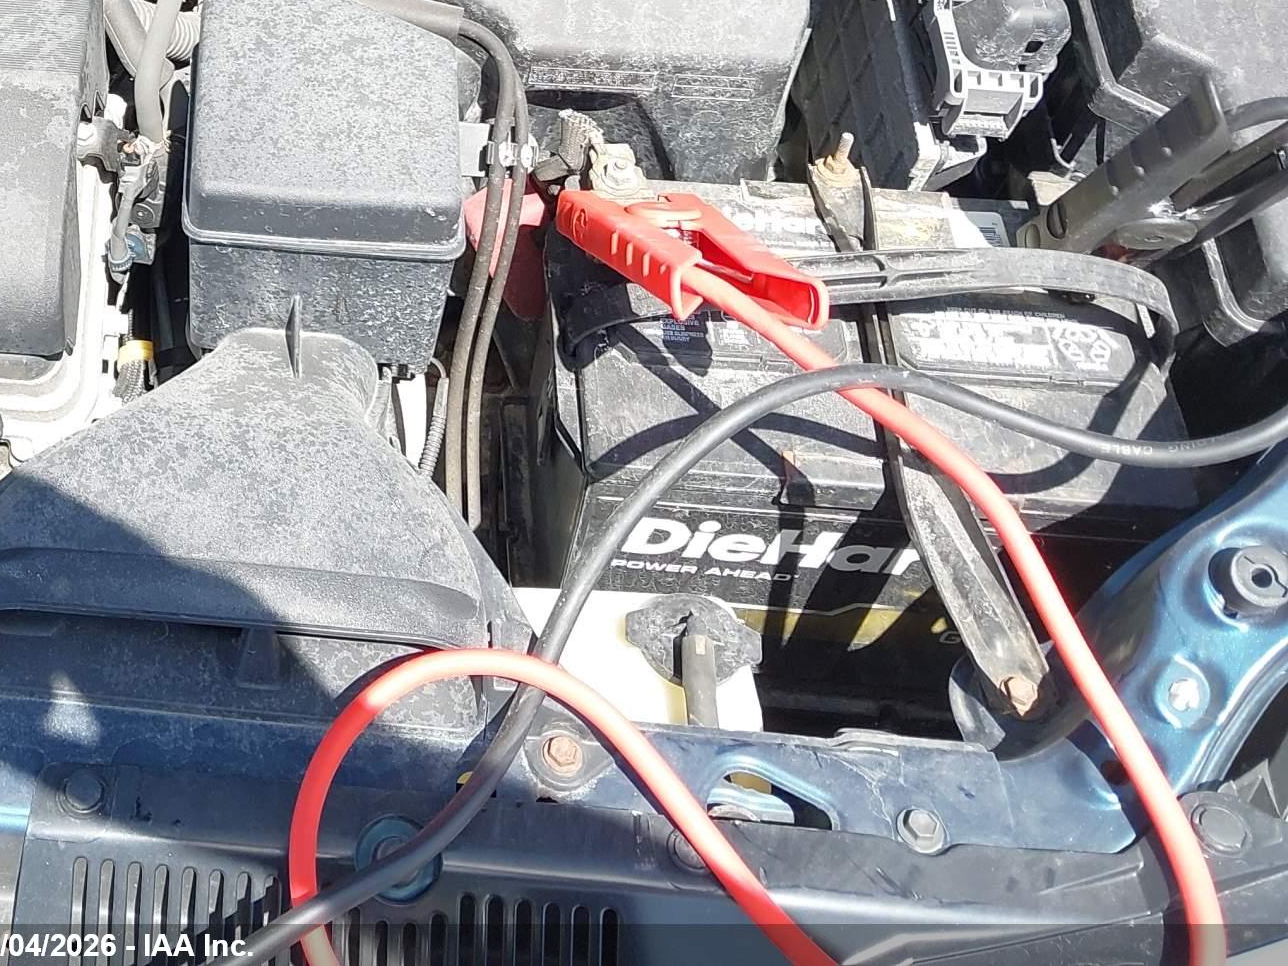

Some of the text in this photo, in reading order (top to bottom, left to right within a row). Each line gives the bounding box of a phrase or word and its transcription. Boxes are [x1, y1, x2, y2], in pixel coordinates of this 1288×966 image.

[1099, 444, 1153, 455] CABLE
[621, 516, 921, 577] DieHar
[610, 559, 793, 582] POWER AHEAD
